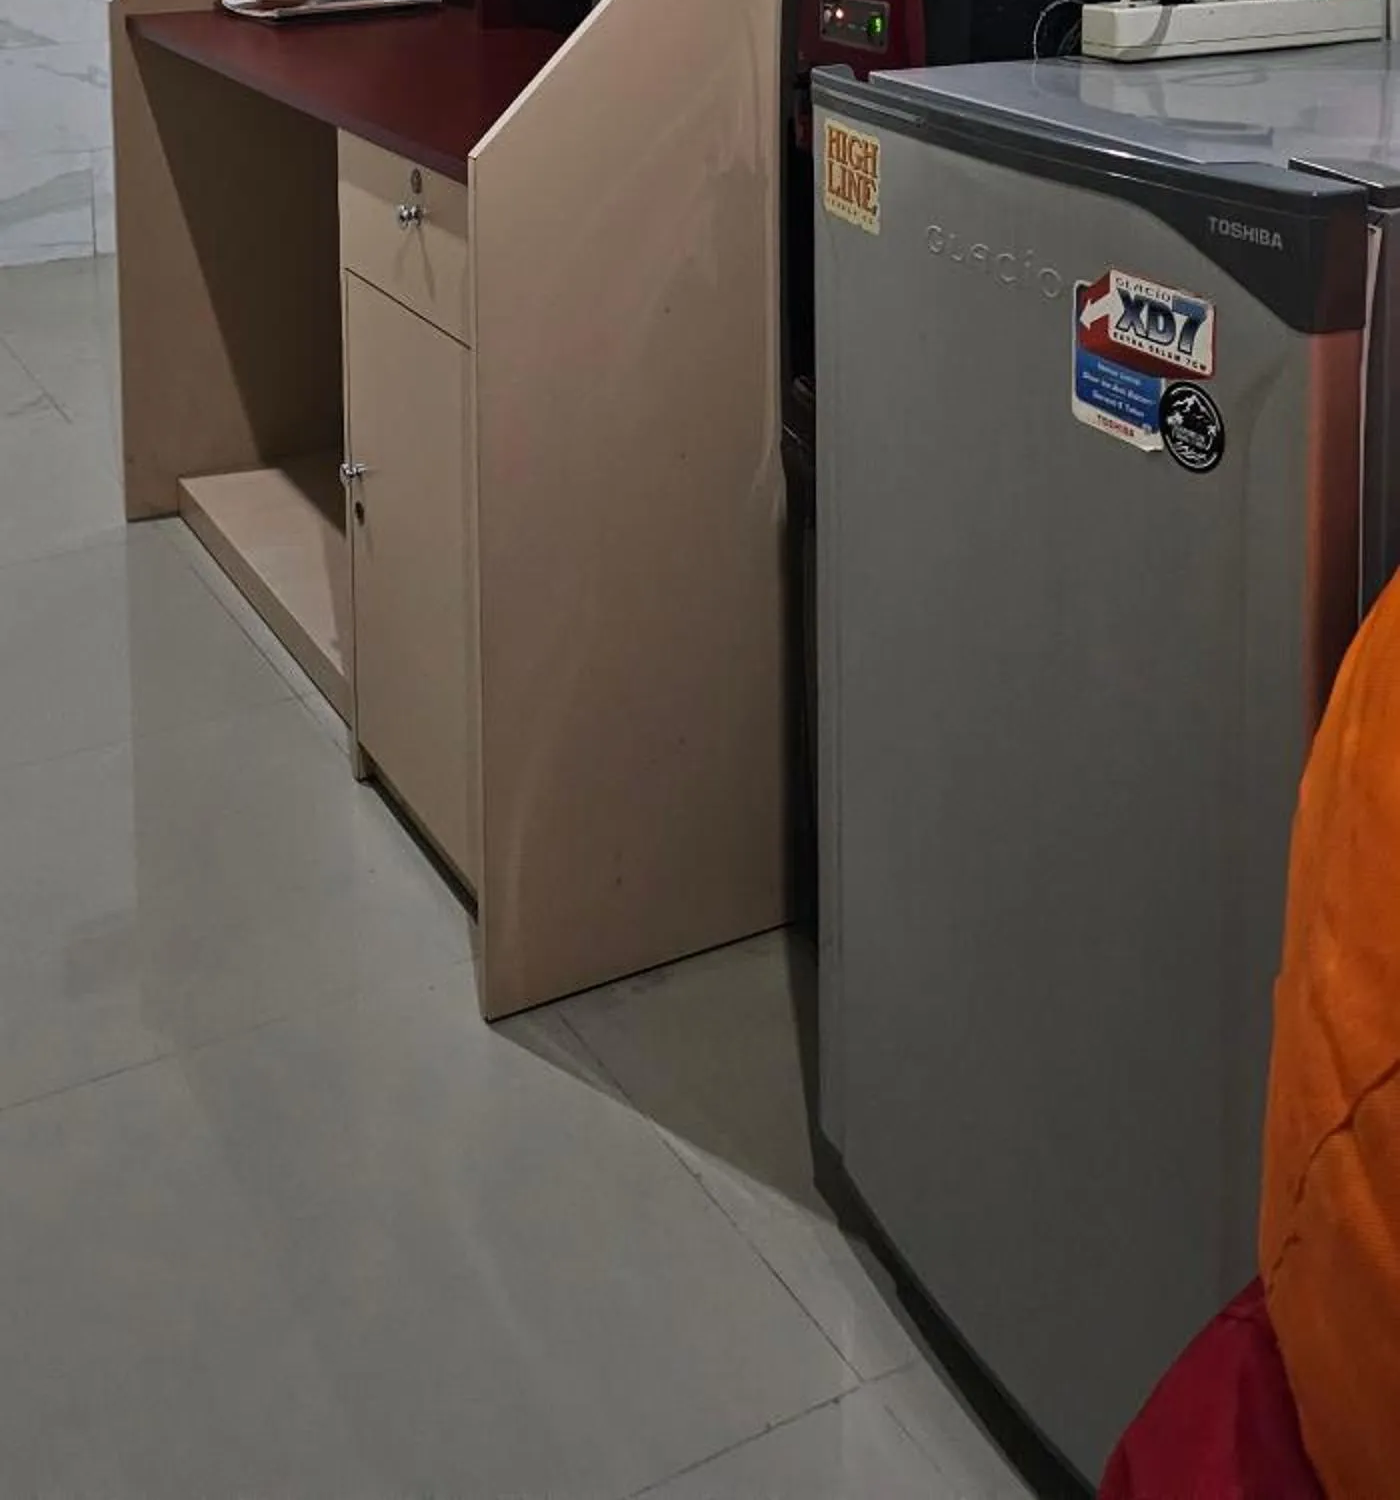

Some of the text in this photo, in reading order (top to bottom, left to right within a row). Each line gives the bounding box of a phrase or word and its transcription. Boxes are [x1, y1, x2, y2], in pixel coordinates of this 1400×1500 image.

[827, 125, 878, 179] HIGH
[827, 160, 877, 216] LINE
[1207, 216, 1283, 251] TOSHIBA
[1115, 287, 1207, 356] XD7
